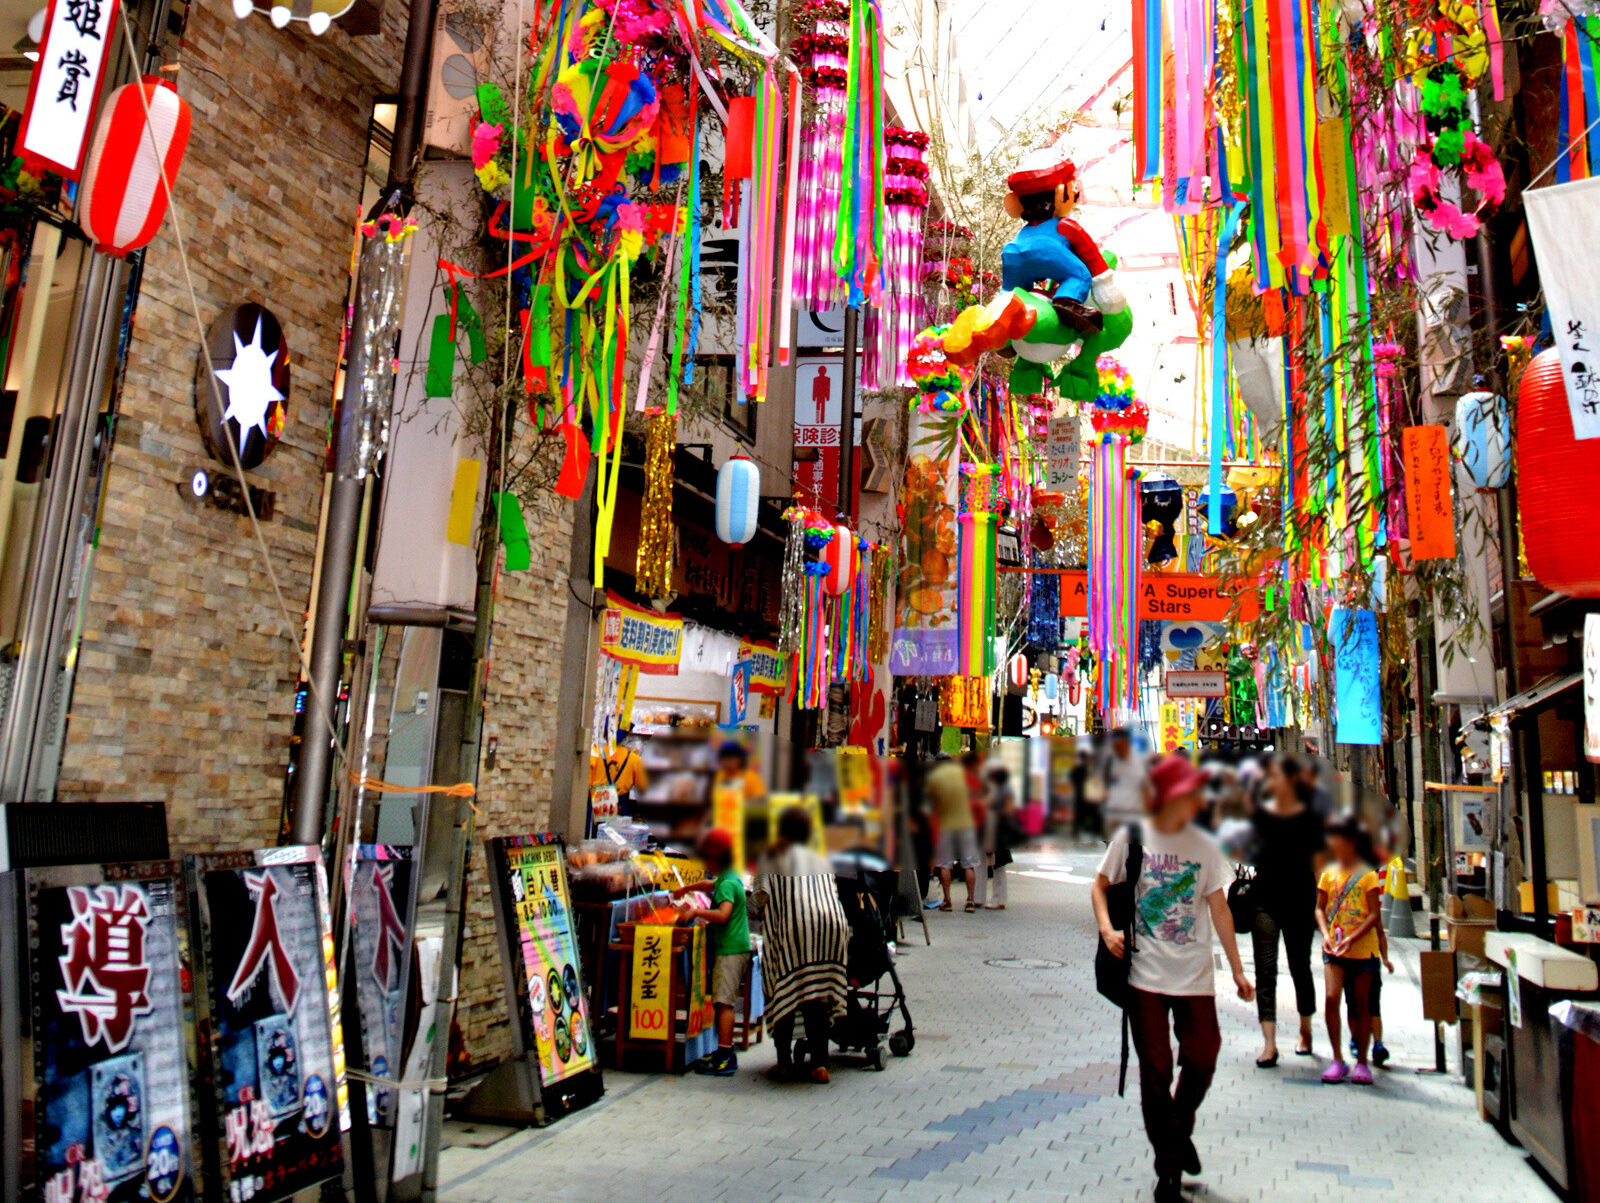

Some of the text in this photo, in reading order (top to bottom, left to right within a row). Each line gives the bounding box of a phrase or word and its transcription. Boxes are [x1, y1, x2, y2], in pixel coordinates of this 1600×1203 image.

[1148, 599, 1192, 614] Stars
[56, 884, 153, 1054] 導
[226, 869, 301, 1019] 入
[634, 1009, 664, 1030] 100
